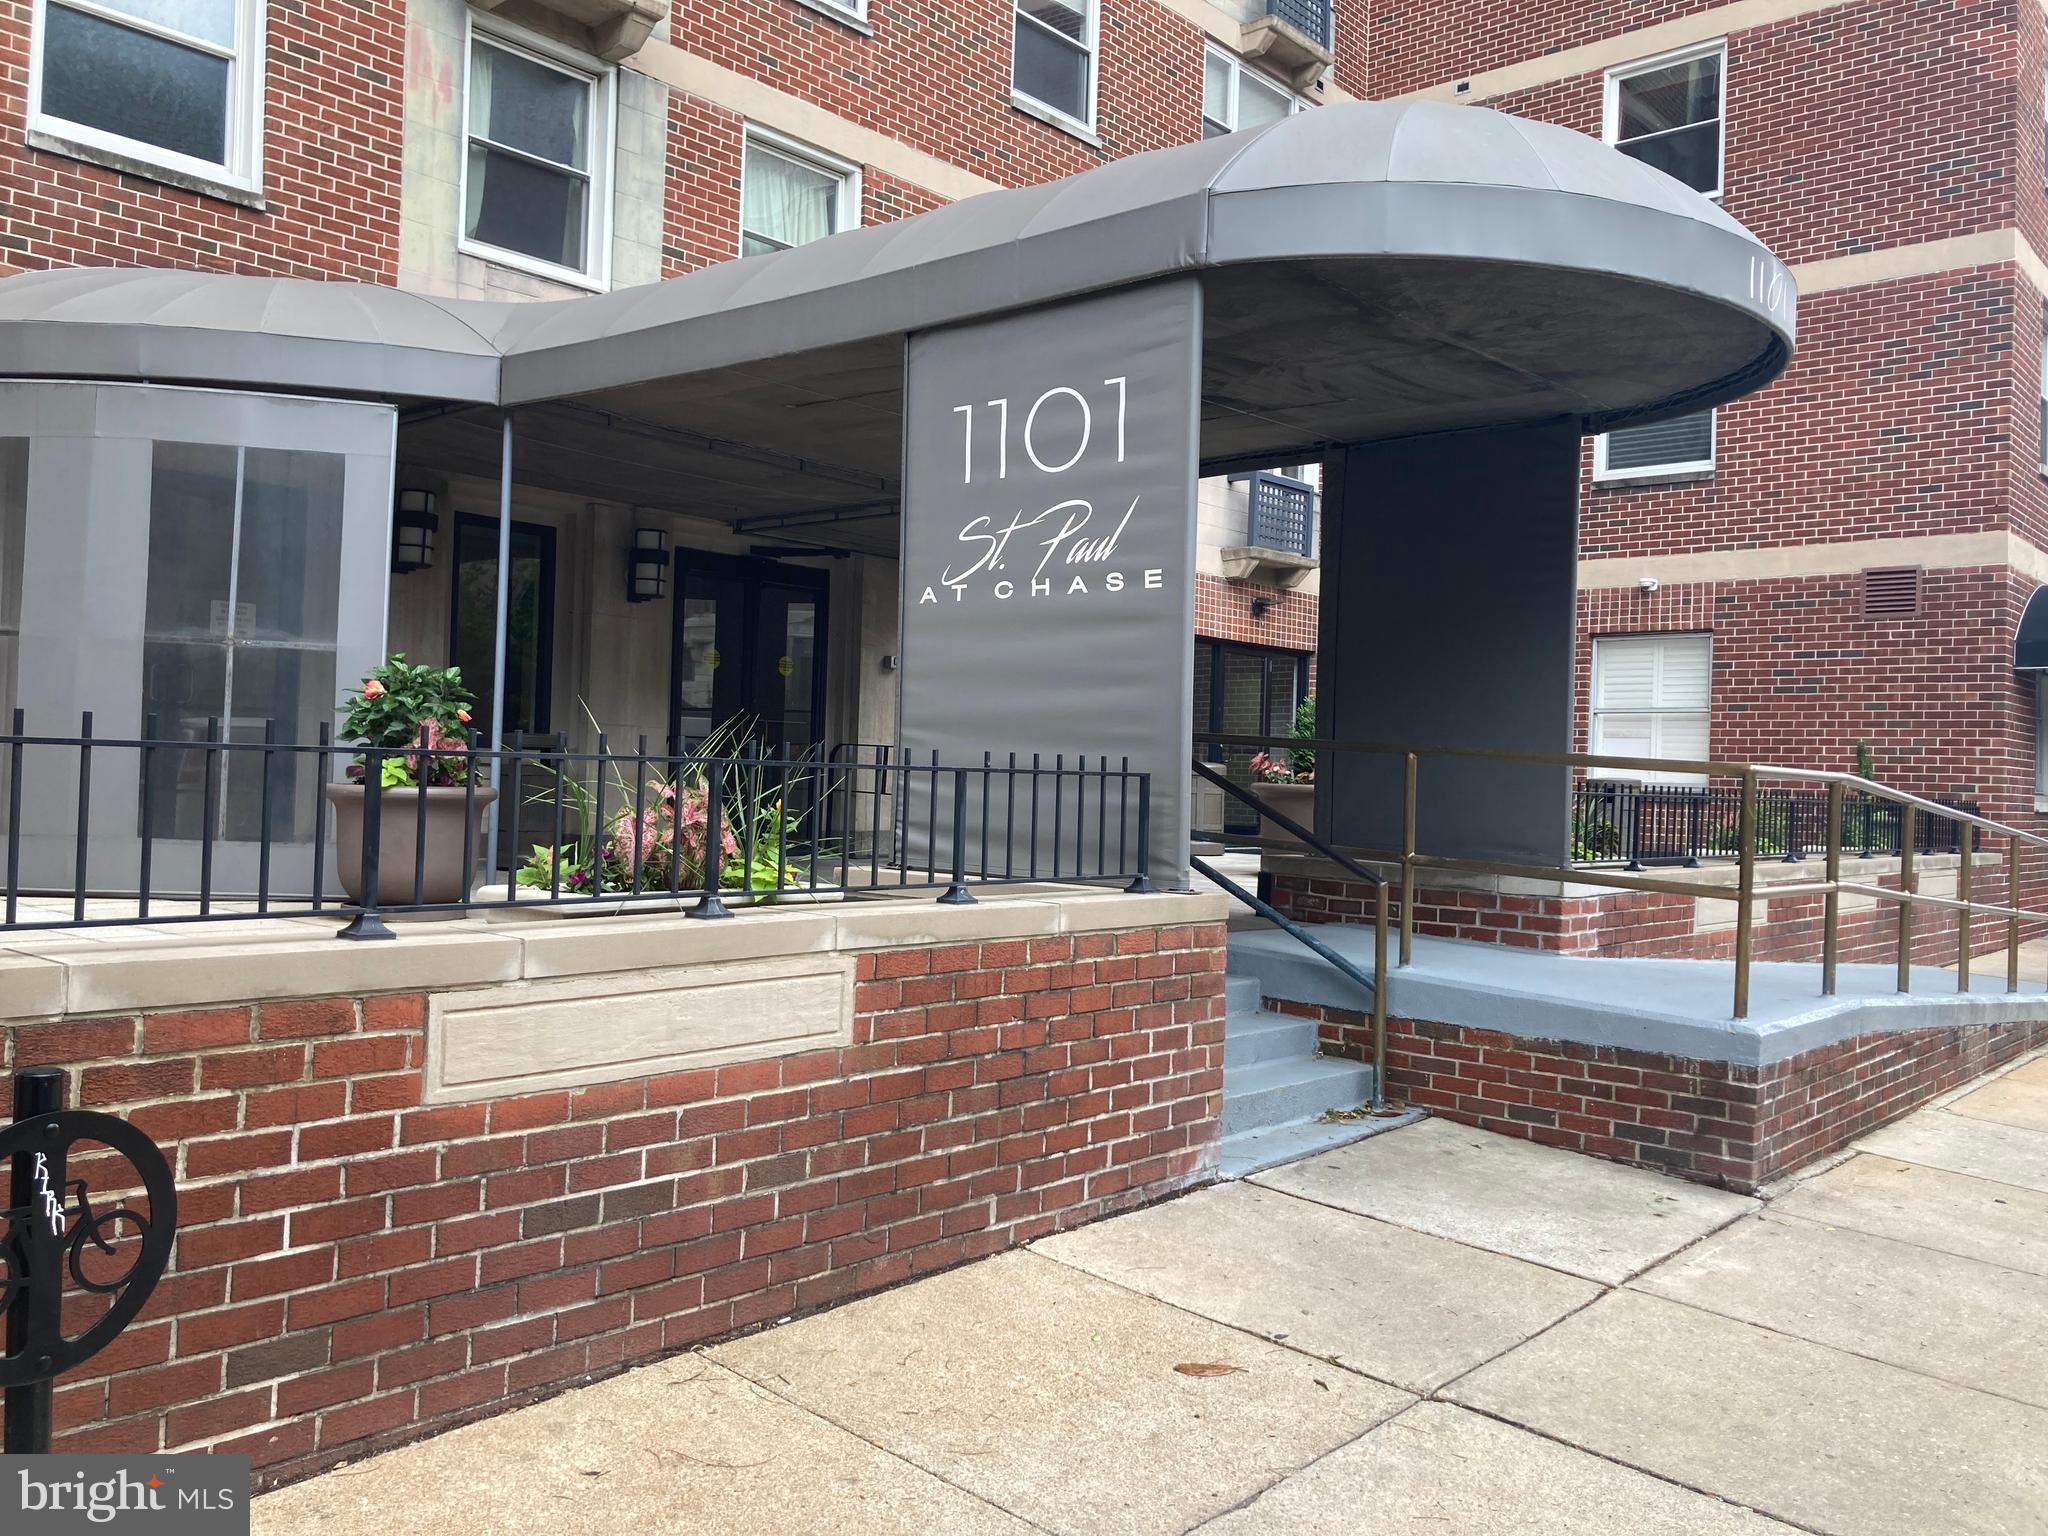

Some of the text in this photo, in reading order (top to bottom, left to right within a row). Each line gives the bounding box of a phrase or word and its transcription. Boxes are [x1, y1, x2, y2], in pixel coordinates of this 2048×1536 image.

[1750, 256, 1787, 320] 1101
[953, 376, 1126, 484] 1101
[941, 495, 1140, 586] St. Paul
[919, 568, 1163, 604] AT CHASE
